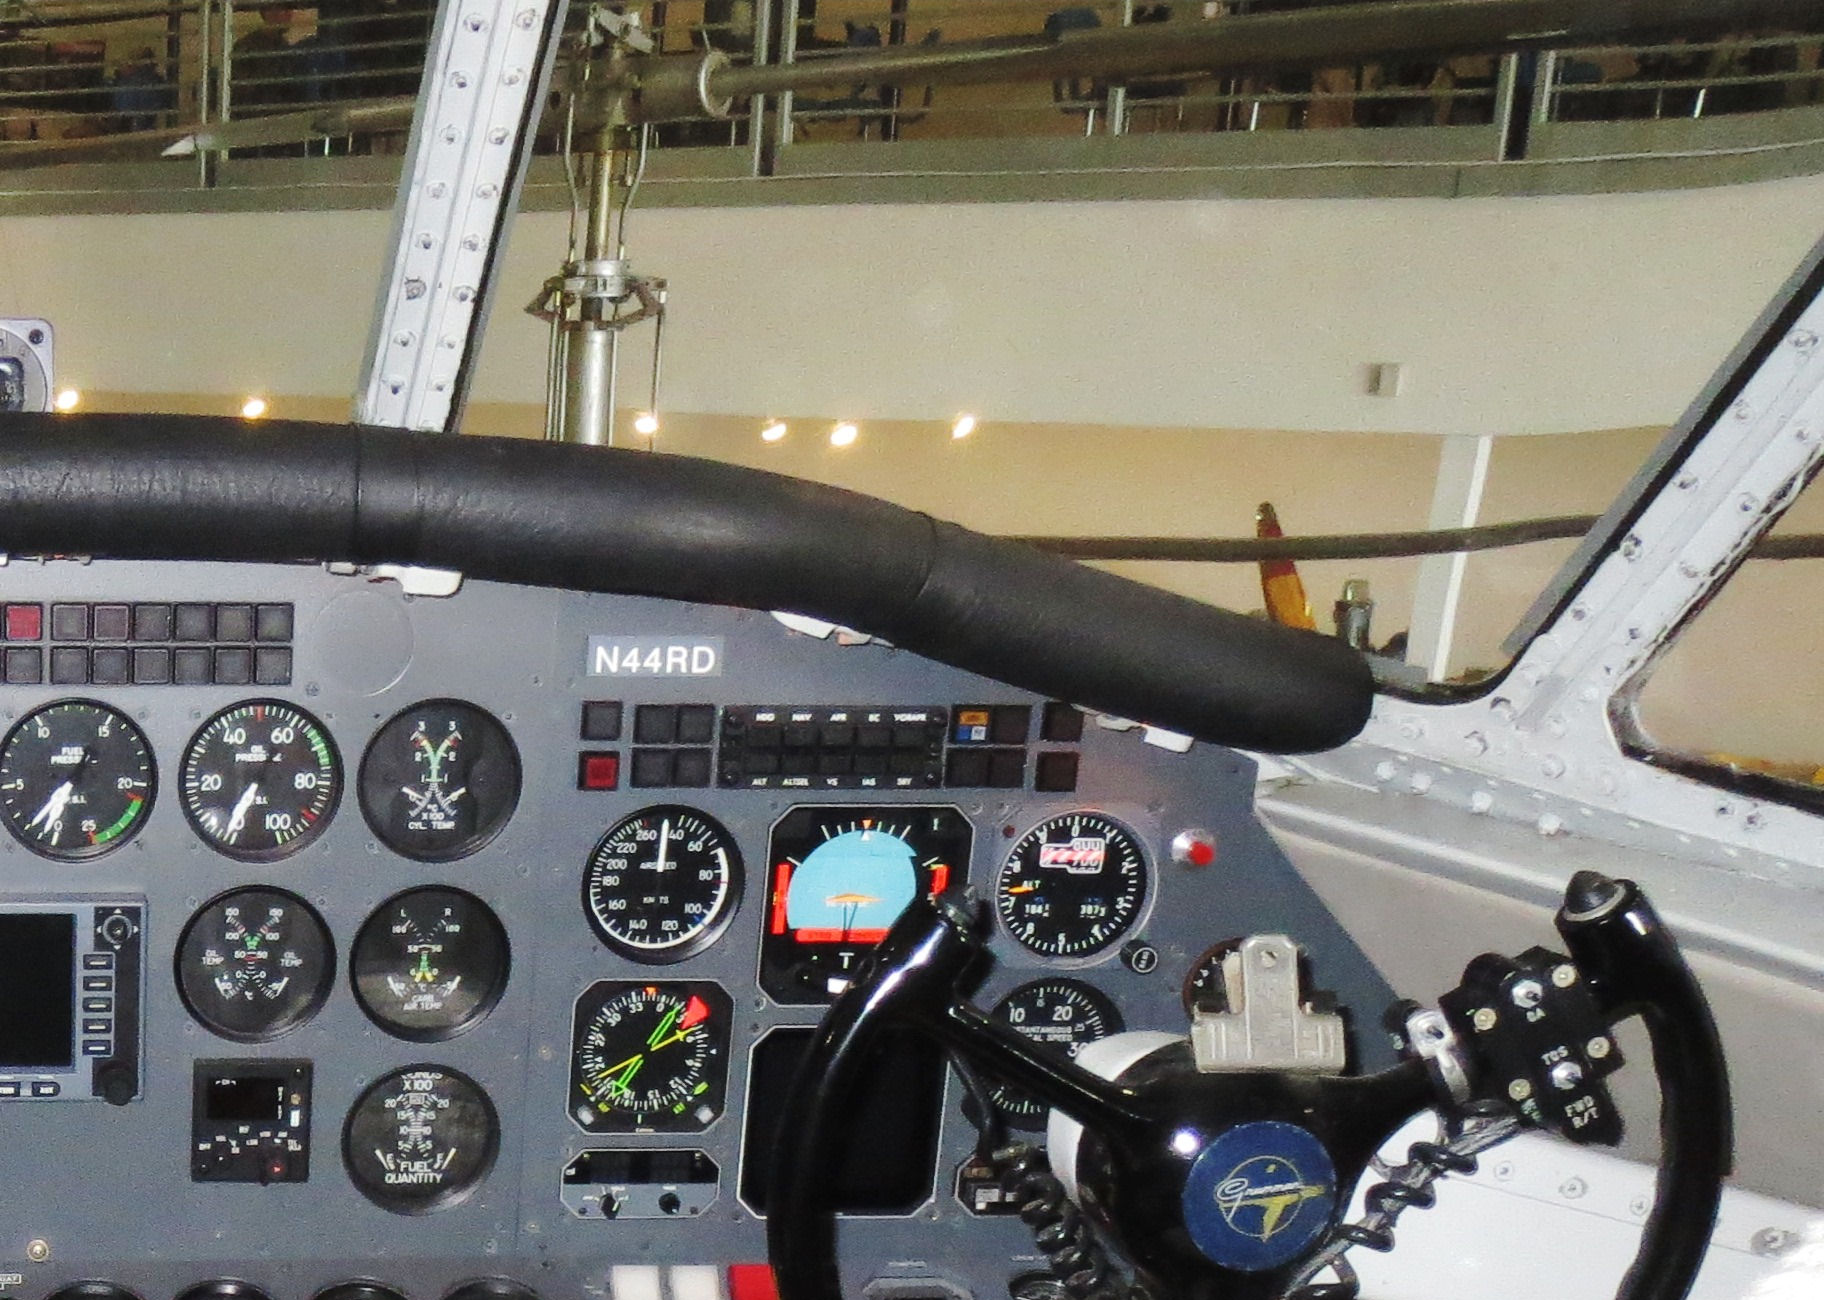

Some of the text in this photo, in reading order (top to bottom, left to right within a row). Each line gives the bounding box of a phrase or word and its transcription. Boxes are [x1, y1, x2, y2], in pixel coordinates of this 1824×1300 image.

[596, 646, 714, 673] N44RD
[38, 724, 49, 738] 10
[99, 723, 109, 737] 15
[224, 725, 245, 744] 40
[271, 728, 293, 743] 60
[201, 775, 221, 790] 20
[295, 773, 316, 789] 80
[266, 814, 290, 829] 100
[699, 870, 713, 880] 80
[609, 900, 626, 909] 160
[685, 904, 701, 913] 100
[401, 1159, 432, 1172] FUEL
[385, 1169, 442, 1183] QUANTITY
